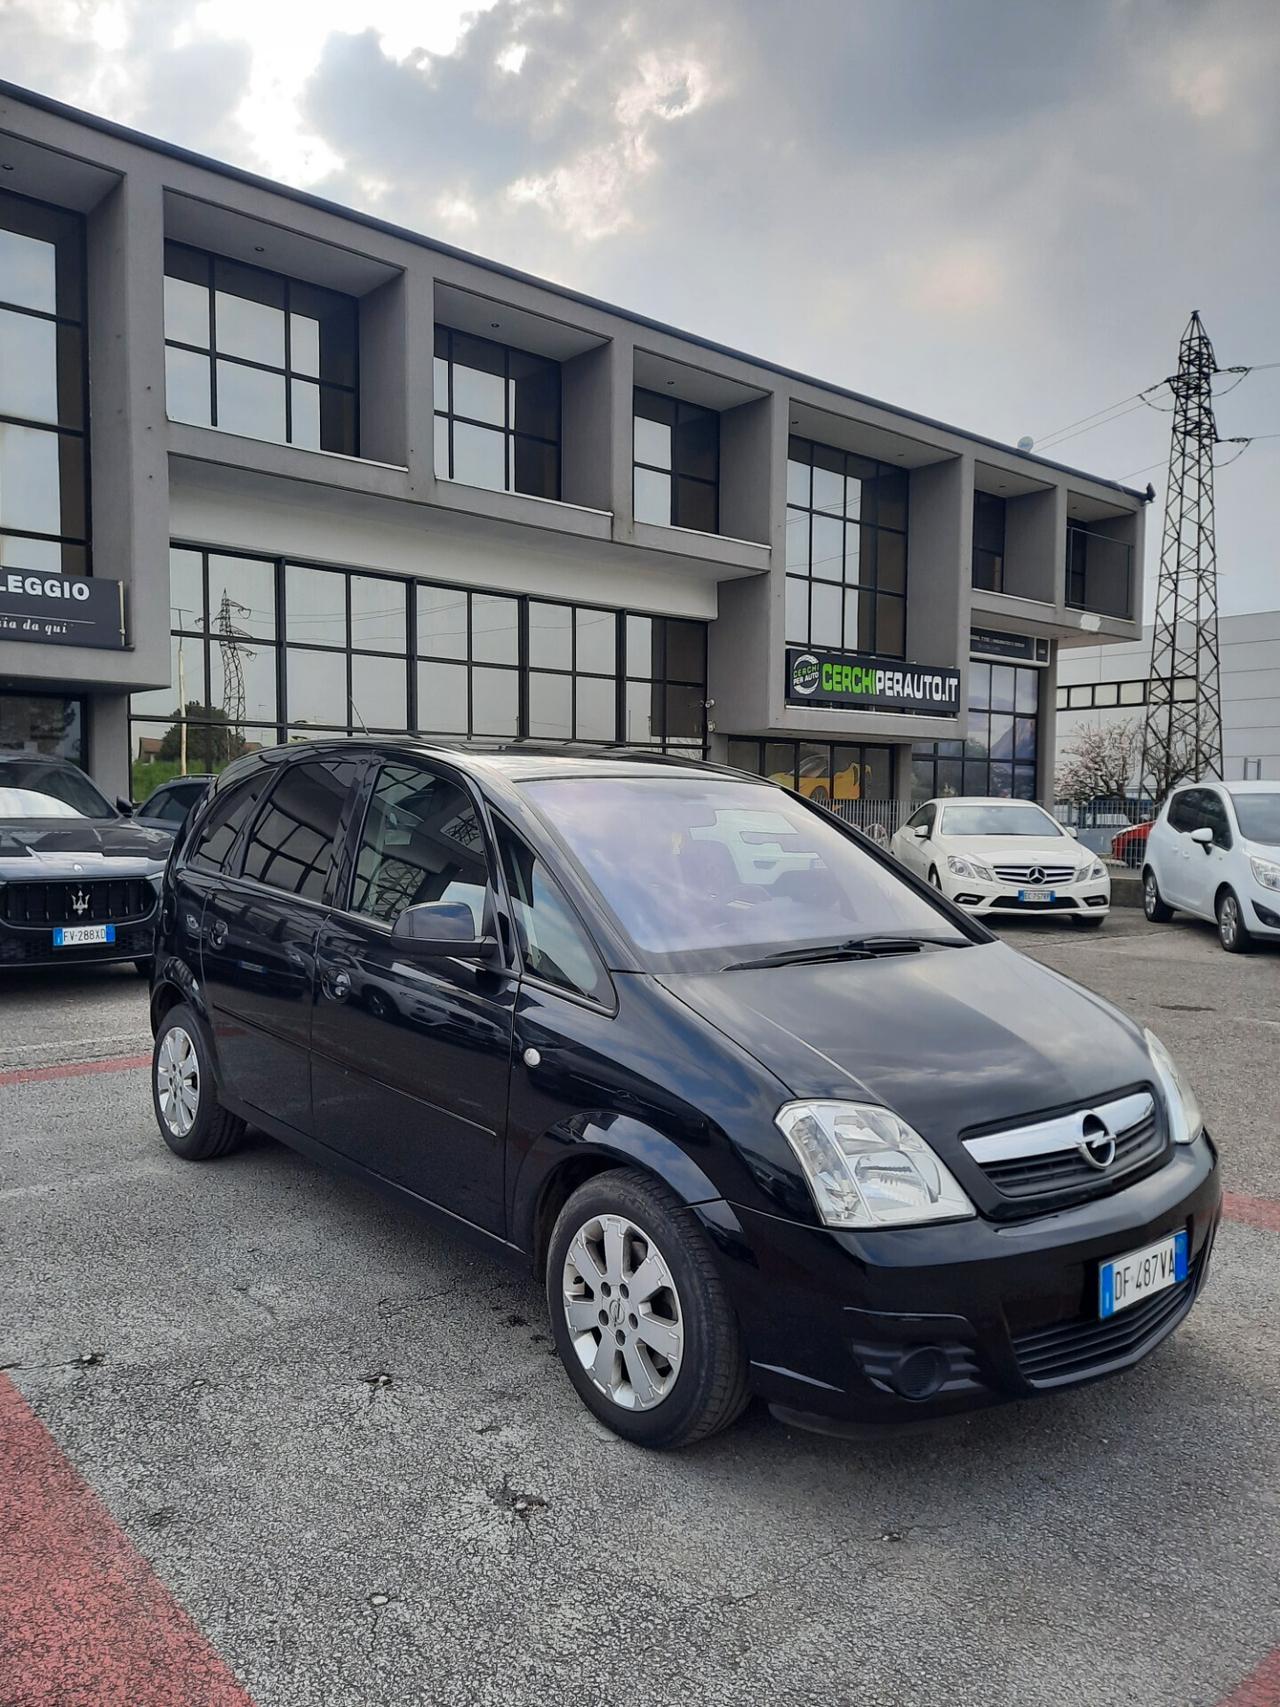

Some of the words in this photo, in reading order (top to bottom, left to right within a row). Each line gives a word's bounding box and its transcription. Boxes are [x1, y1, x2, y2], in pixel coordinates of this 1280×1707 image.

[0, 617, 17, 629] ia
[22, 619, 39, 631] da
[793, 664, 820, 678] CERCHI
[793, 676, 804, 686] PER
[804, 671, 820, 682] AUTO
[822, 663, 959, 702] CERCHIPERAUTO.IT
